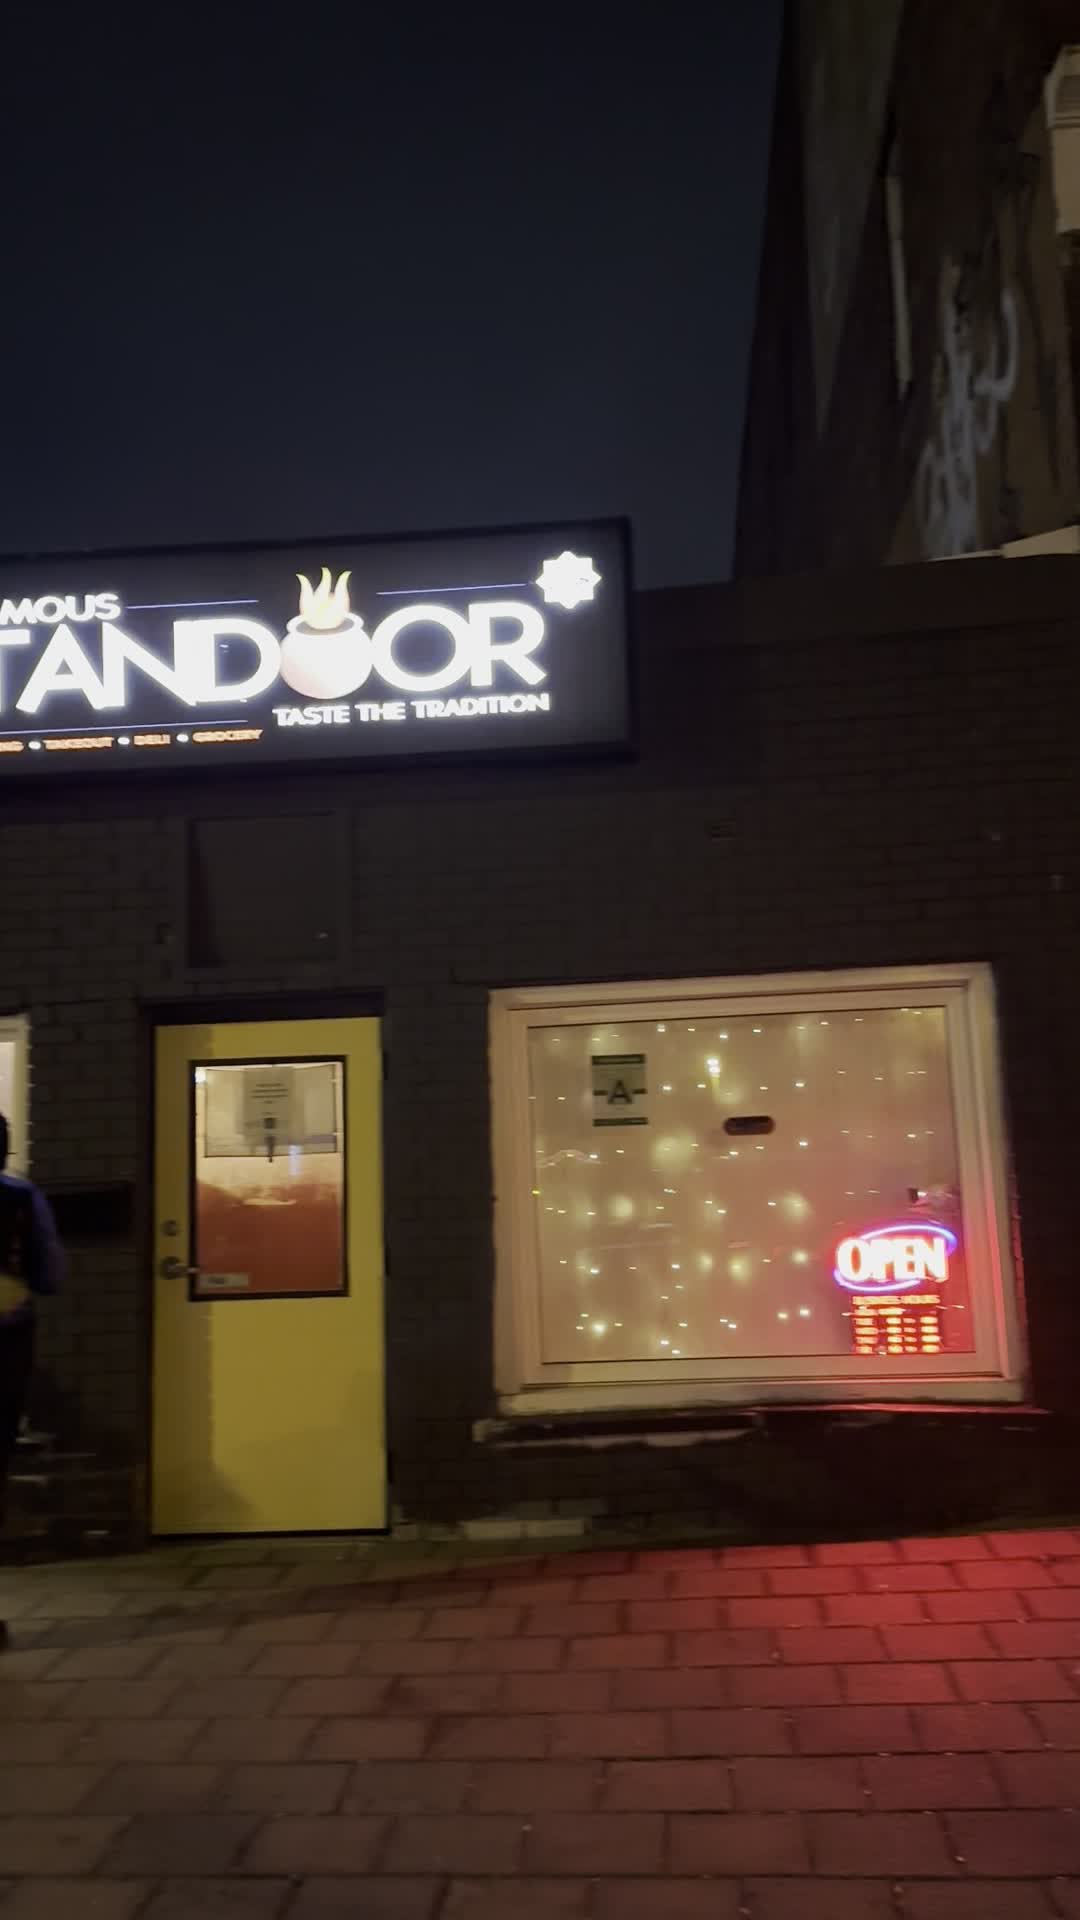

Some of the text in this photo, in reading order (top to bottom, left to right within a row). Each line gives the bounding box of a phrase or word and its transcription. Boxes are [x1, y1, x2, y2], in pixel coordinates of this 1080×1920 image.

[272, 692, 550, 726] TASTE THE TRADITION
[607, 1079, 633, 1105] A
[836, 1236, 948, 1283] OPEN
